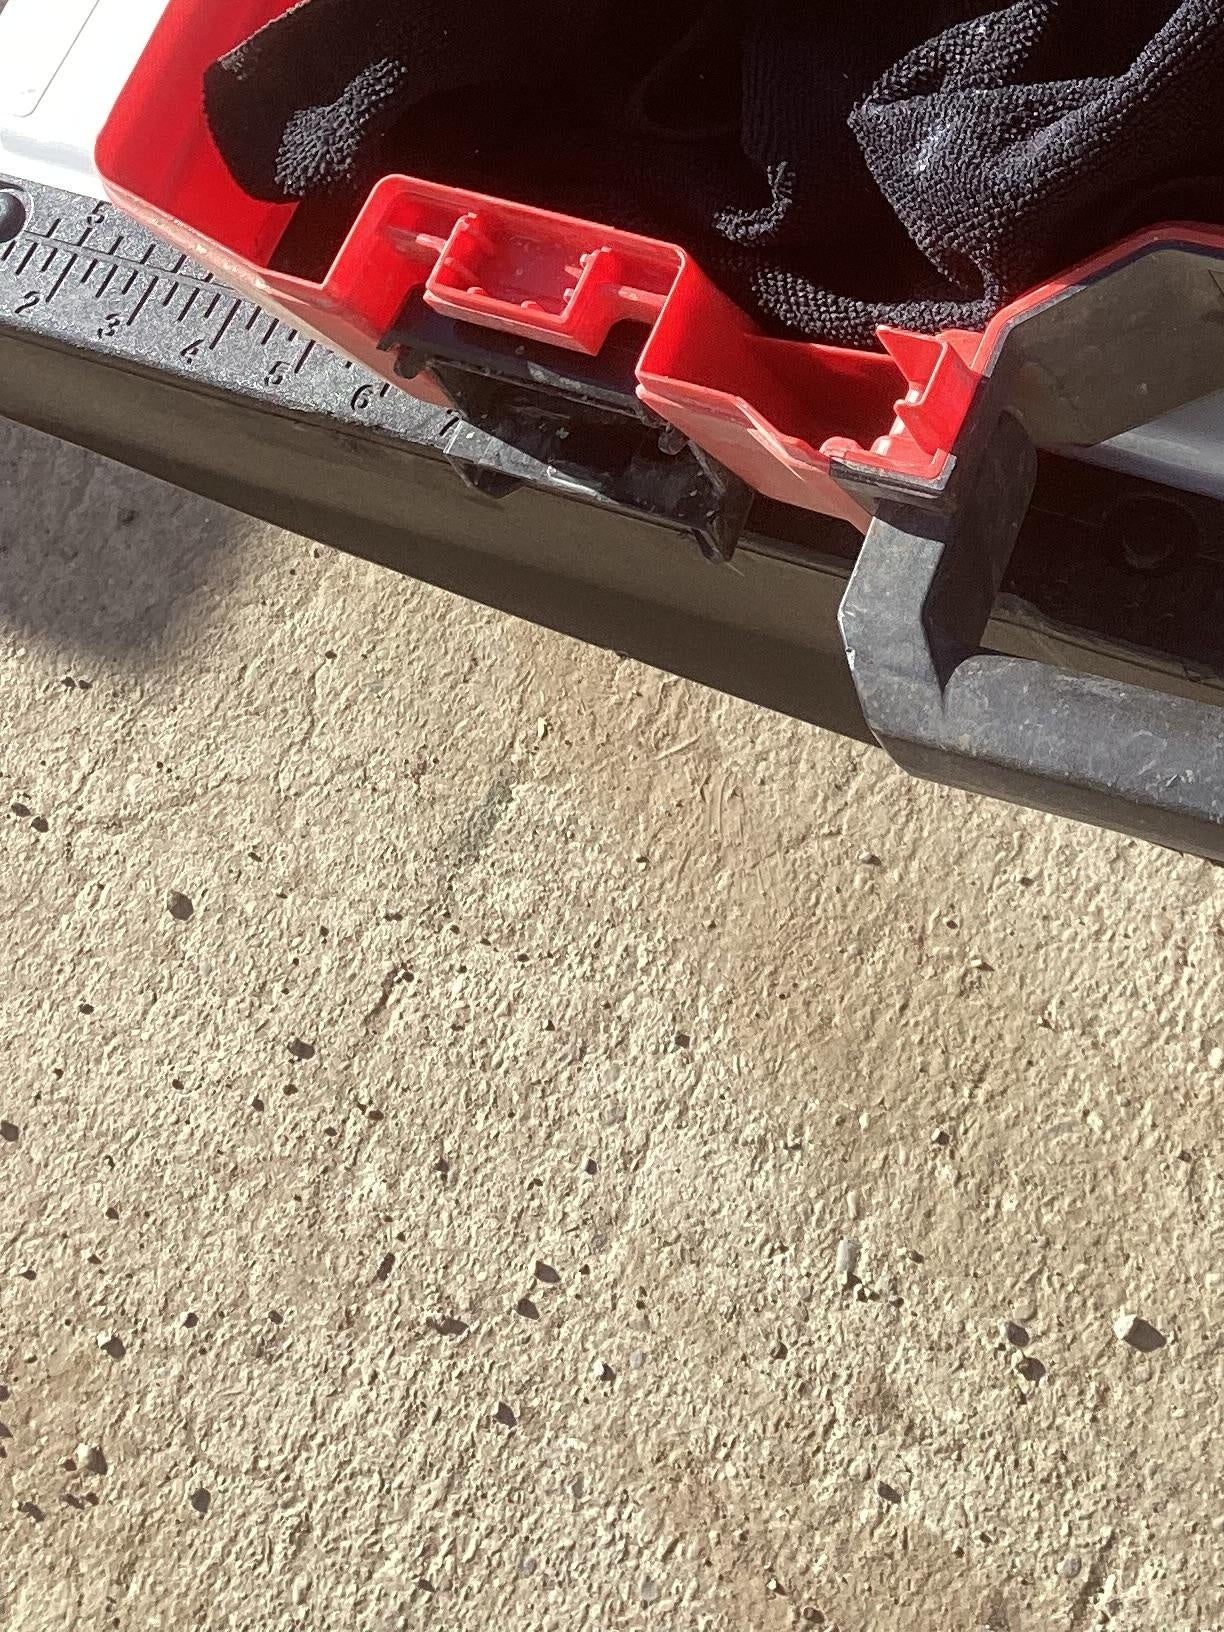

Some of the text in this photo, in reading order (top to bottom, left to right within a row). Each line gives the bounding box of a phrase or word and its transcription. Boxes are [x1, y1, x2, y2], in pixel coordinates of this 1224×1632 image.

[86, 200, 112, 225] 5
[14, 290, 41, 314] 2
[97, 312, 121, 339] 3
[264, 360, 290, 386] 5
[350, 383, 375, 411] 6
